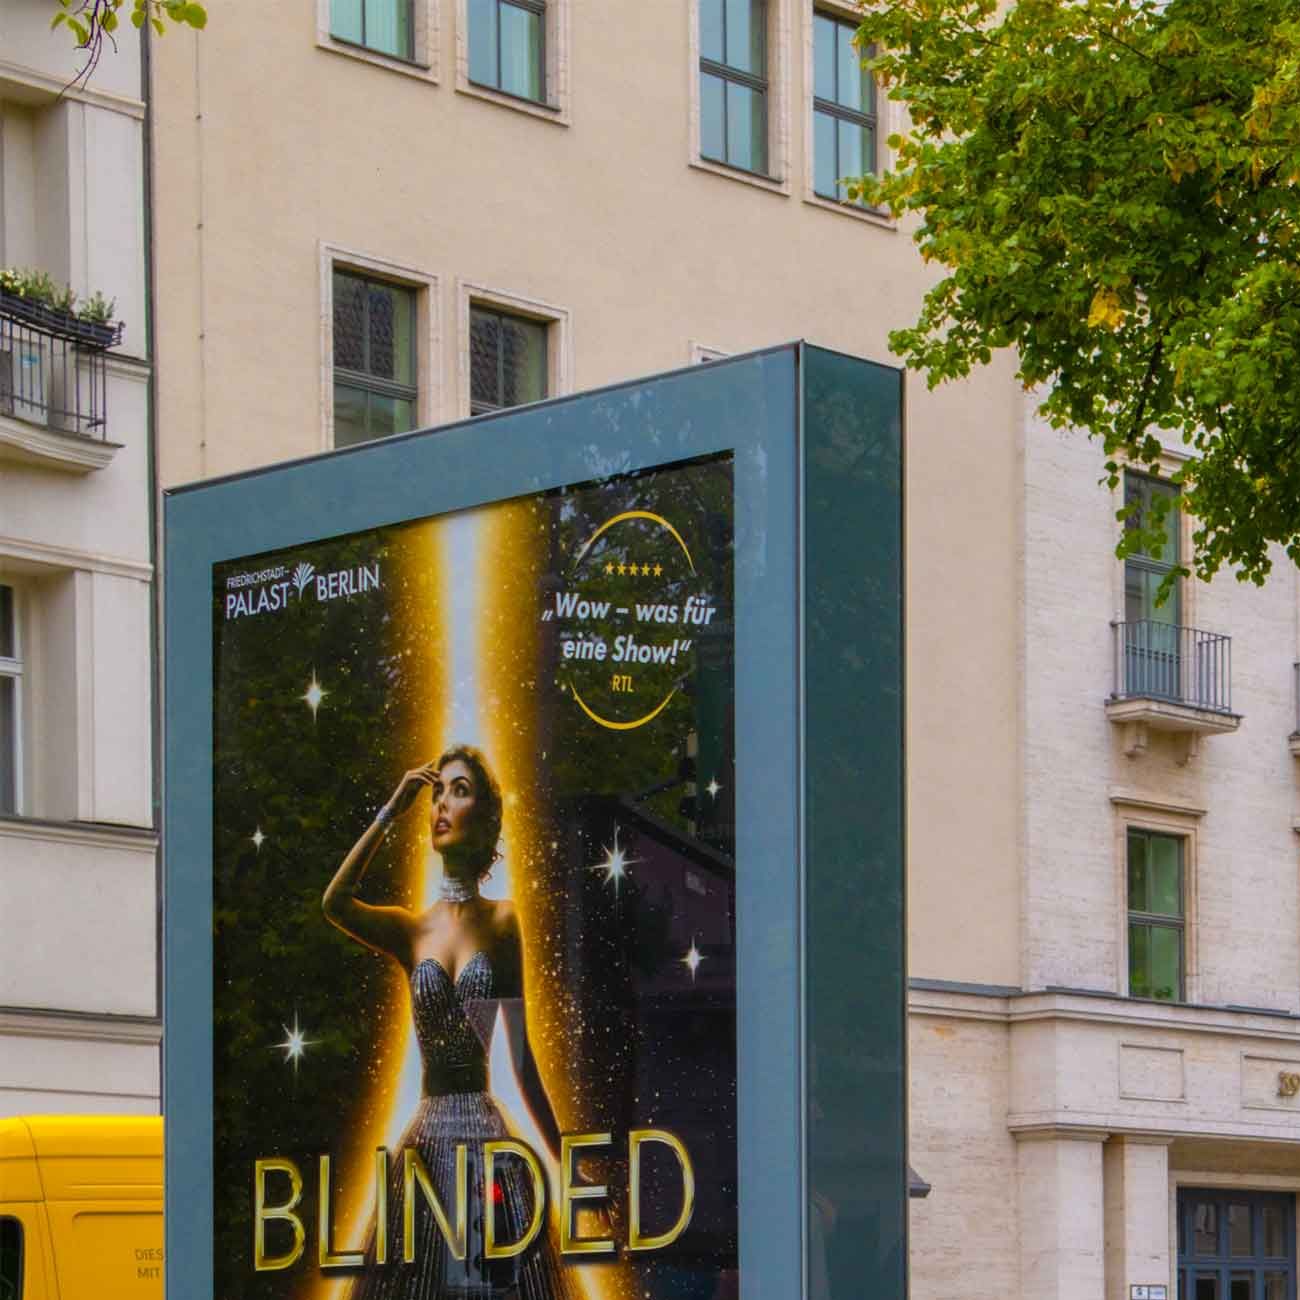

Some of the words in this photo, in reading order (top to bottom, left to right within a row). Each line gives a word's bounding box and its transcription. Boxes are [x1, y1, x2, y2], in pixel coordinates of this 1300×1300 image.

[225, 581, 290, 620] PALAST
[316, 563, 381, 602] BERLIN
[635, 603, 679, 623] was
[682, 595, 717, 626] für
[562, 637, 607, 661] eine
[611, 673, 635, 693] RTL
[253, 1128, 696, 1273] BLINDED
